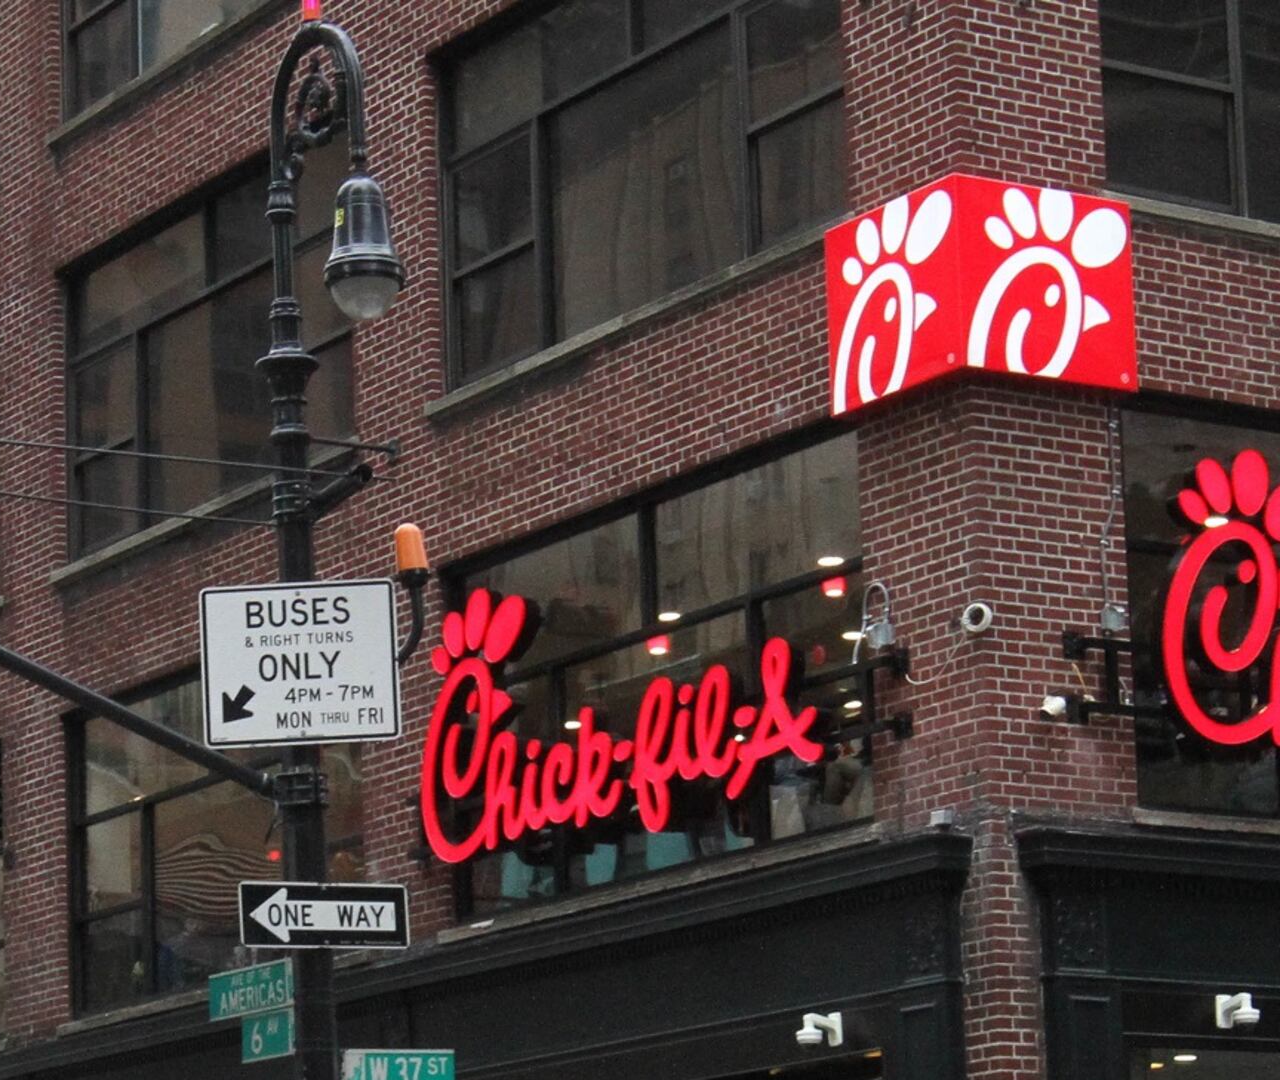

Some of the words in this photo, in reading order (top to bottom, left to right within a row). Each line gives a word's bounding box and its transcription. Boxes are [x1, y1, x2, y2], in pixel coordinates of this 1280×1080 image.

[245, 596, 350, 629] BUSES
[244, 636, 254, 648] &
[260, 633, 301, 647] RIGHT
[306, 630, 354, 645] TURNS
[258, 650, 341, 682] ONLY
[284, 686, 321, 704] 4PM
[338, 684, 375, 701] 7PM
[276, 711, 312, 729] MON
[320, 712, 350, 725] THRU
[357, 707, 384, 725] FRI
[422, 637, 823, 863] Chick-fil-A
[267, 903, 314, 927] ONE
[336, 905, 385, 928] WAY
[220, 979, 285, 1013] AMERICAS
[250, 1021, 263, 1055] 6
[427, 1056, 449, 1075] ST
